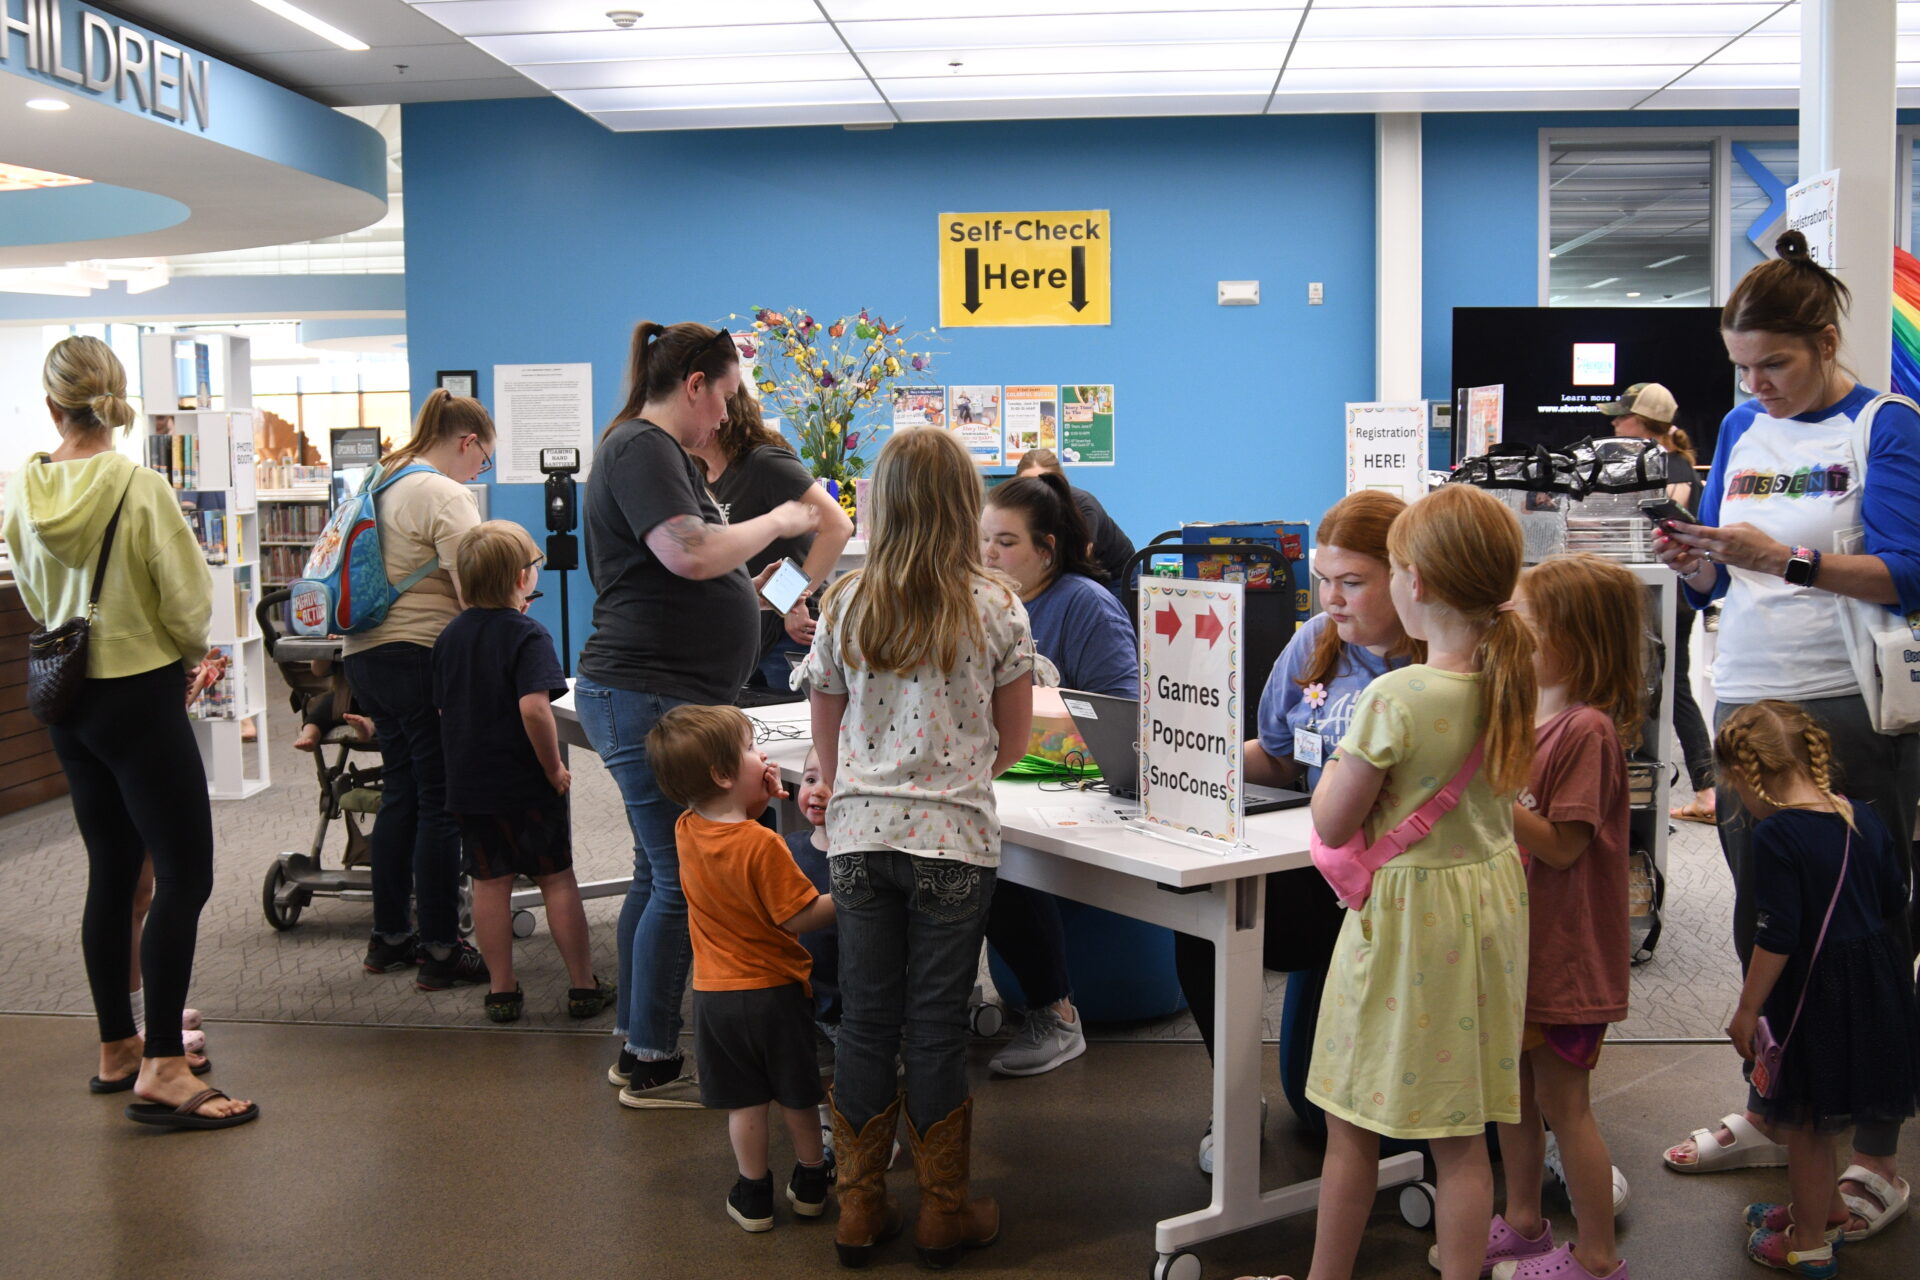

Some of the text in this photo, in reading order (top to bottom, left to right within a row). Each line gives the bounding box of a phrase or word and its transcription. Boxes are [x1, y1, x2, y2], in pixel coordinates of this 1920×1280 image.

[950, 218, 1100, 243] Self-Check
[984, 263, 1068, 290] Here
[1561, 394, 1587, 402] Learn
[1356, 427, 1417, 441] Registration
[1364, 454, 1406, 468] HERE!
[1729, 473, 1844, 495] DISSENT
[1158, 675, 1220, 708] Games
[1153, 719, 1226, 756] Popcorn
[1150, 765, 1228, 801] SnoCones
